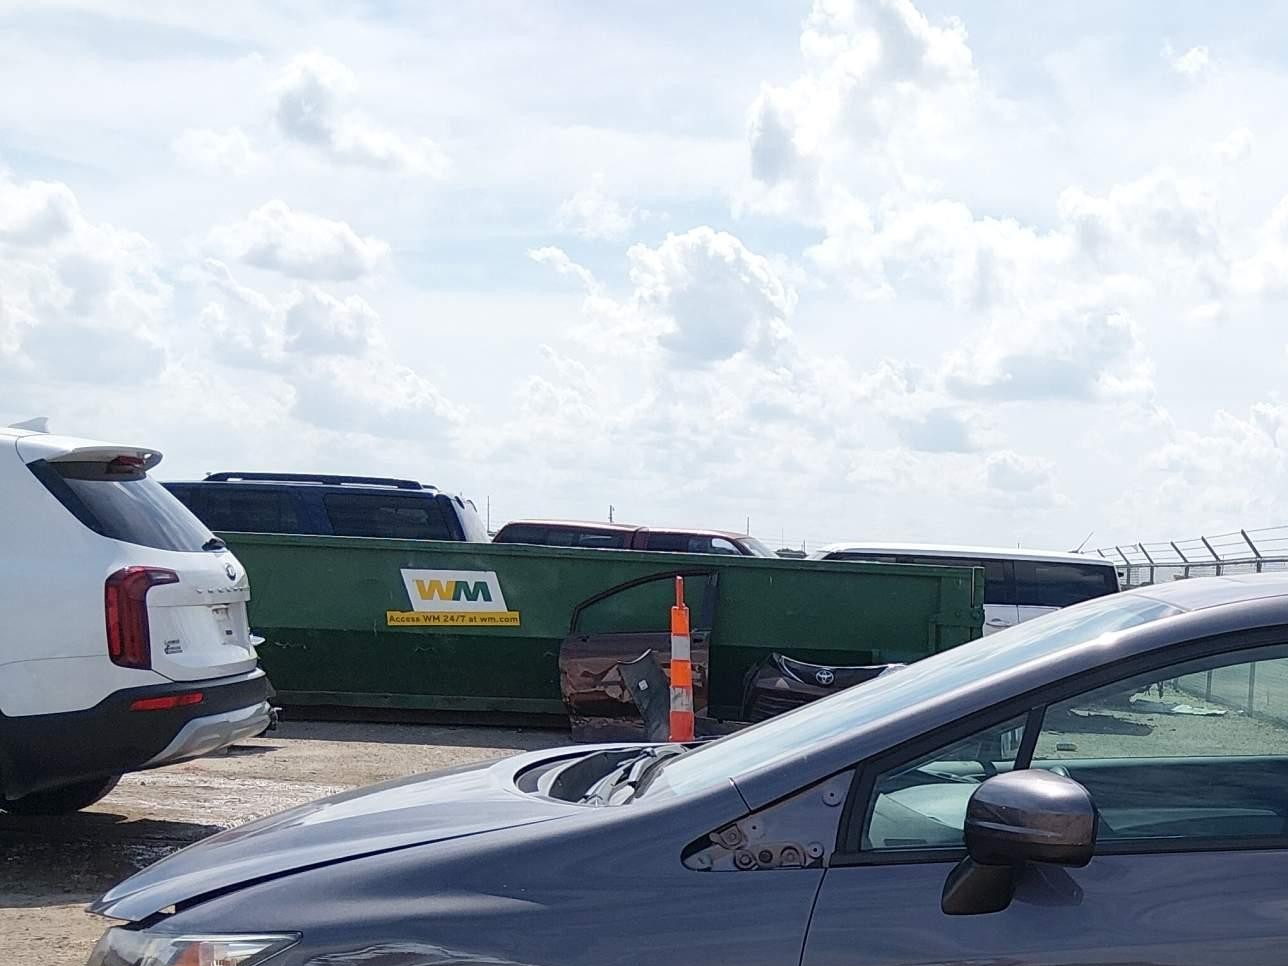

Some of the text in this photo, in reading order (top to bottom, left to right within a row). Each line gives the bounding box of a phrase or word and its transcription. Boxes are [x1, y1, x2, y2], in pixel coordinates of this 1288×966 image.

[415, 579, 493, 602] WM
[389, 615, 421, 623] Access
[423, 615, 441, 623] WM
[443, 615, 465, 623] 24/7
[468, 615, 477, 623] at
